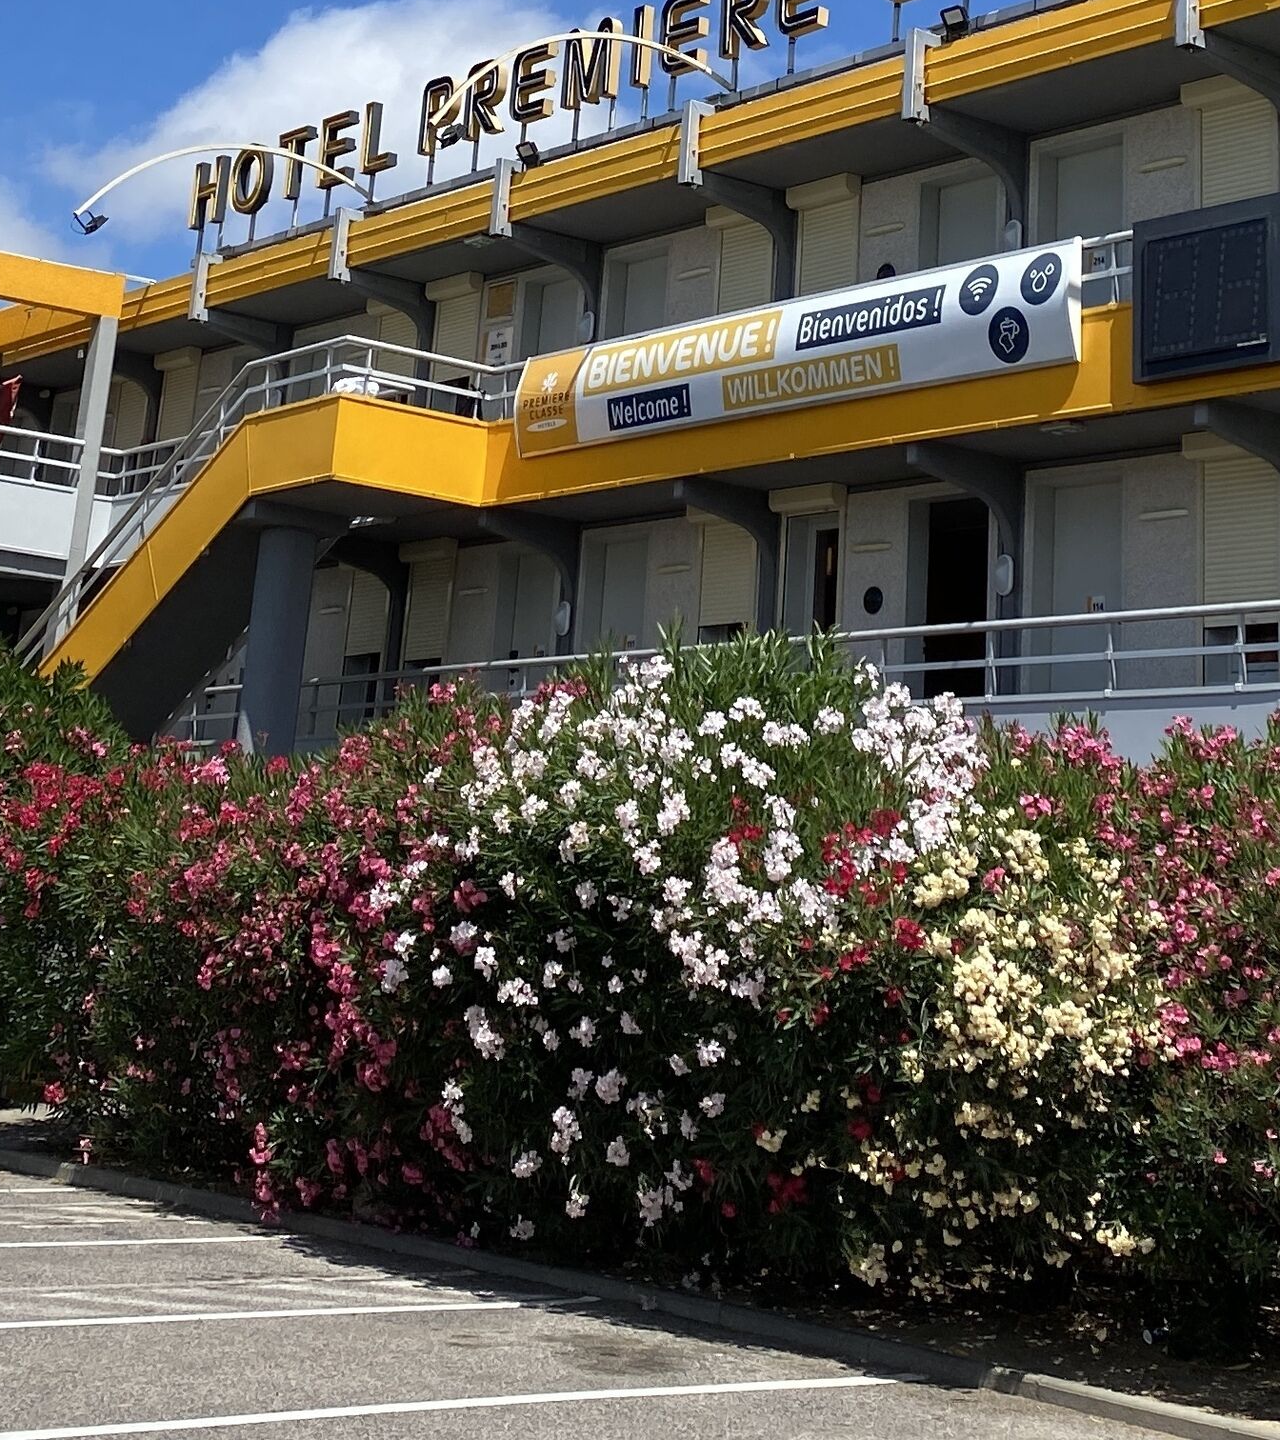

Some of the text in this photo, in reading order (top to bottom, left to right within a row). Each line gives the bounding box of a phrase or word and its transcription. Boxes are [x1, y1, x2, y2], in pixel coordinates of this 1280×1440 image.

[187, 101, 397, 230] HOTEL
[523, 390, 570, 410] PREMIERE
[529, 405, 564, 420] CLASSE
